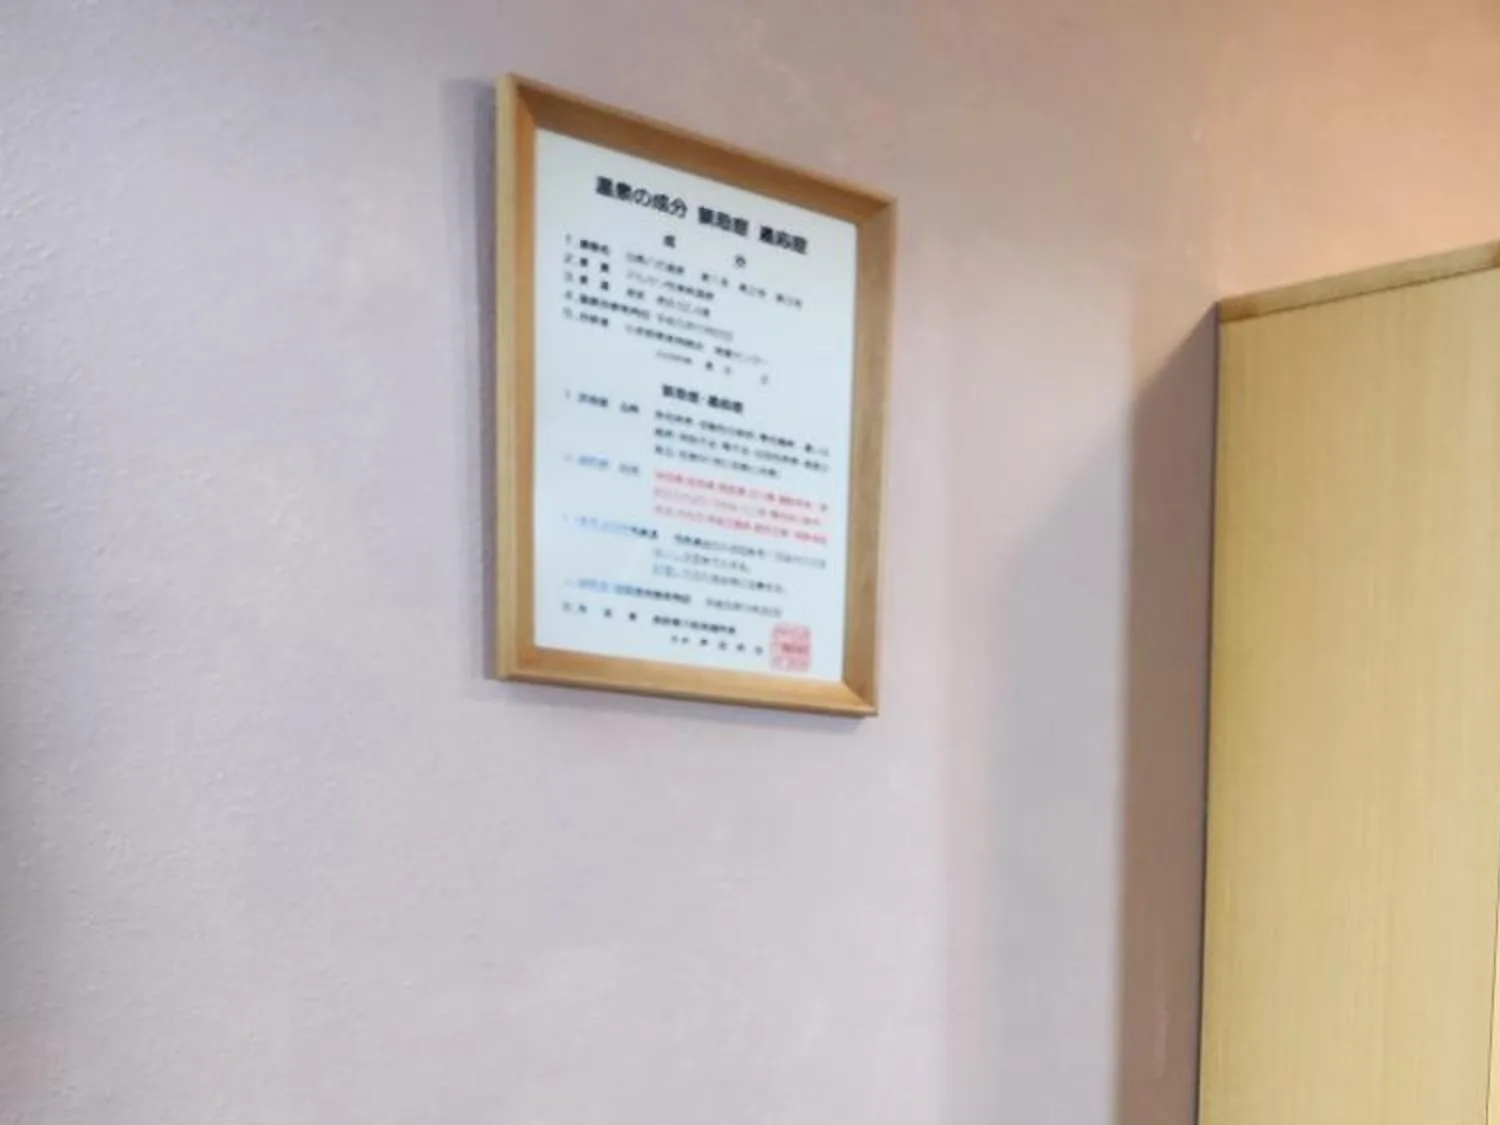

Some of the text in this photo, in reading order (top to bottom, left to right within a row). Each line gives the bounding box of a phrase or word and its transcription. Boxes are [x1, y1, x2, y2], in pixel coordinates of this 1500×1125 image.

[596, 175, 688, 218] 温泉の成分
